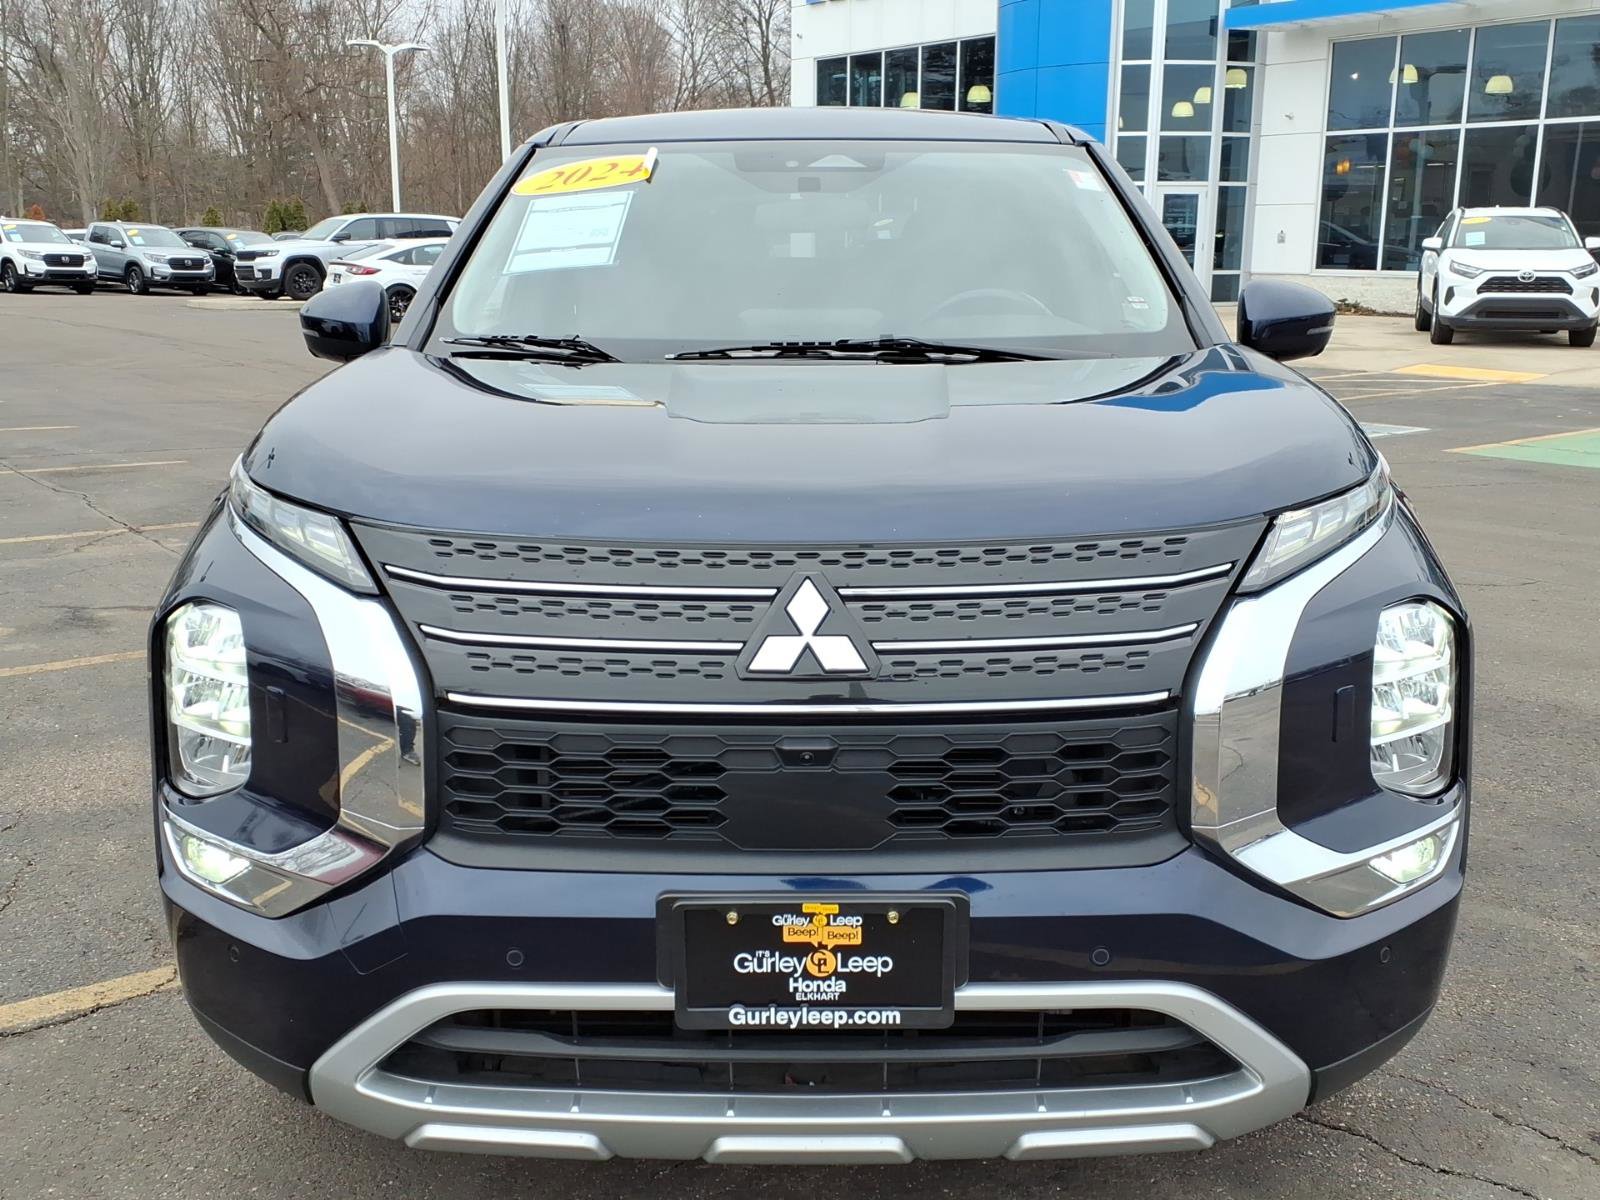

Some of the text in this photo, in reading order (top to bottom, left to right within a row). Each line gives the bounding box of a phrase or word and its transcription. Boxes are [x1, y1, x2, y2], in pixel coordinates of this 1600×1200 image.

[535, 161, 645, 190] 2024
[830, 914, 863, 928] Leep
[787, 927, 859, 942] Beep! Beep!
[733, 952, 807, 977] Gurley
[836, 951, 894, 977] Leep
[789, 977, 846, 993] Honda
[795, 992, 841, 1001] ELKHART
[728, 1006, 901, 1029] Gurleyleep.com
